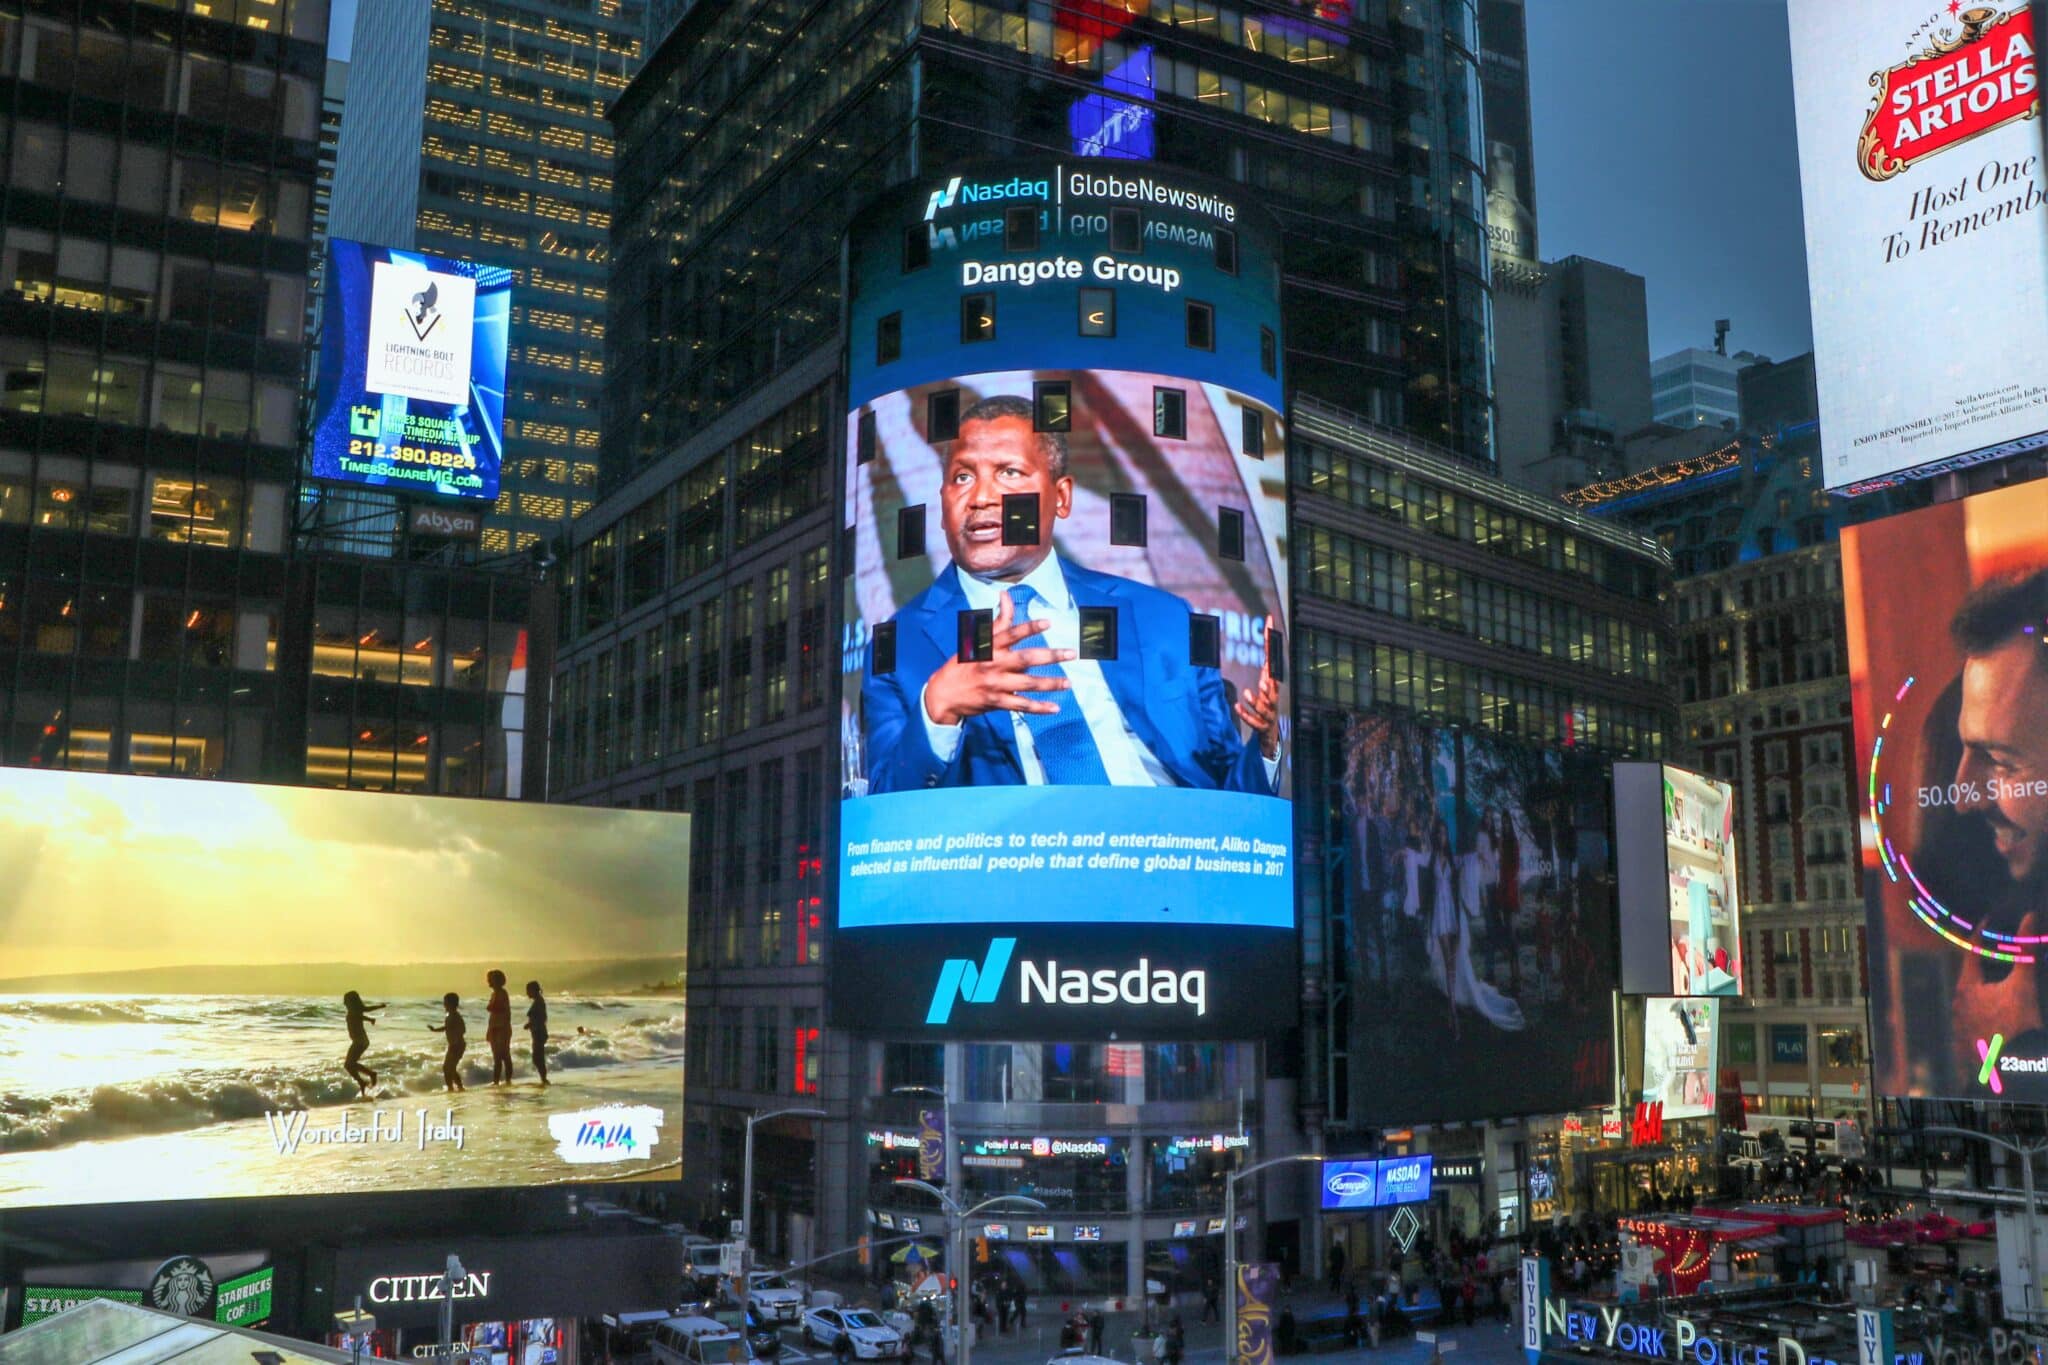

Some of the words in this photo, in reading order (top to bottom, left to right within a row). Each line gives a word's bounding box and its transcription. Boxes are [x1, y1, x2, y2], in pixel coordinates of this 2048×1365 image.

[1892, 33, 2034, 115] STELLA
[1894, 64, 2037, 149] ARTOIS
[962, 178, 1048, 204] Nasdaq
[1070, 174, 1235, 222] GlobeNewswire
[1910, 177, 1967, 221] Host
[1977, 156, 2036, 193] One
[1882, 232, 1910, 263] To
[962, 255, 1083, 287] Dangote
[1092, 255, 1181, 291] Group
[384, 354, 456, 380] RECORDS
[386, 342, 431, 359] LIGHTNING
[433, 349, 454, 362] BOLT
[386, 422, 444, 440] MULTIMEDIA
[418, 416, 457, 431] SQUARE
[1854, 434, 1879, 447] ENJOY
[1880, 417, 1932, 440] RESPONSIBLY
[350, 440, 476, 470] 212.390.8224
[1918, 781, 1981, 808] 50.0%
[848, 841, 869, 857] From
[871, 838, 913, 854] finance
[916, 834, 943, 850] and
[946, 832, 1004, 854] politics
[1008, 833, 1026, 848] to
[1031, 832, 1068, 848] tech
[1072, 832, 1105, 847] and
[1109, 833, 1219, 853] entertainment,
[1221, 836, 1251, 853] Aliko
[850, 859, 891, 877] selected
[893, 861, 908, 874] as
[910, 854, 983, 873] influential
[987, 853, 1045, 873] people
[1050, 853, 1083, 870] that
[1088, 852, 1140, 870] define
[1144, 854, 1191, 873] global
[1195, 855, 1251, 874] business
[1253, 859, 1263, 875] in
[1265, 861, 1285, 877] 2017
[1021, 958, 1206, 1016] Nasdaq
[2000, 1055, 2048, 1072] 23and
[265, 1109, 405, 1154] Wonderful
[416, 1108, 466, 1151] Italy
[576, 1119, 638, 1155] ITALIA
[1052, 1141, 1105, 1154] @Nasdaq
[1386, 1164, 1421, 1183] NASDAQ
[1617, 1216, 1667, 1235] TACOS
[218, 1277, 273, 1308] STARBUCKS
[1526, 1262, 1538, 1346] NYPD
[1545, 1298, 1597, 1342] NEW
[1602, 1307, 1668, 1358] YORK
